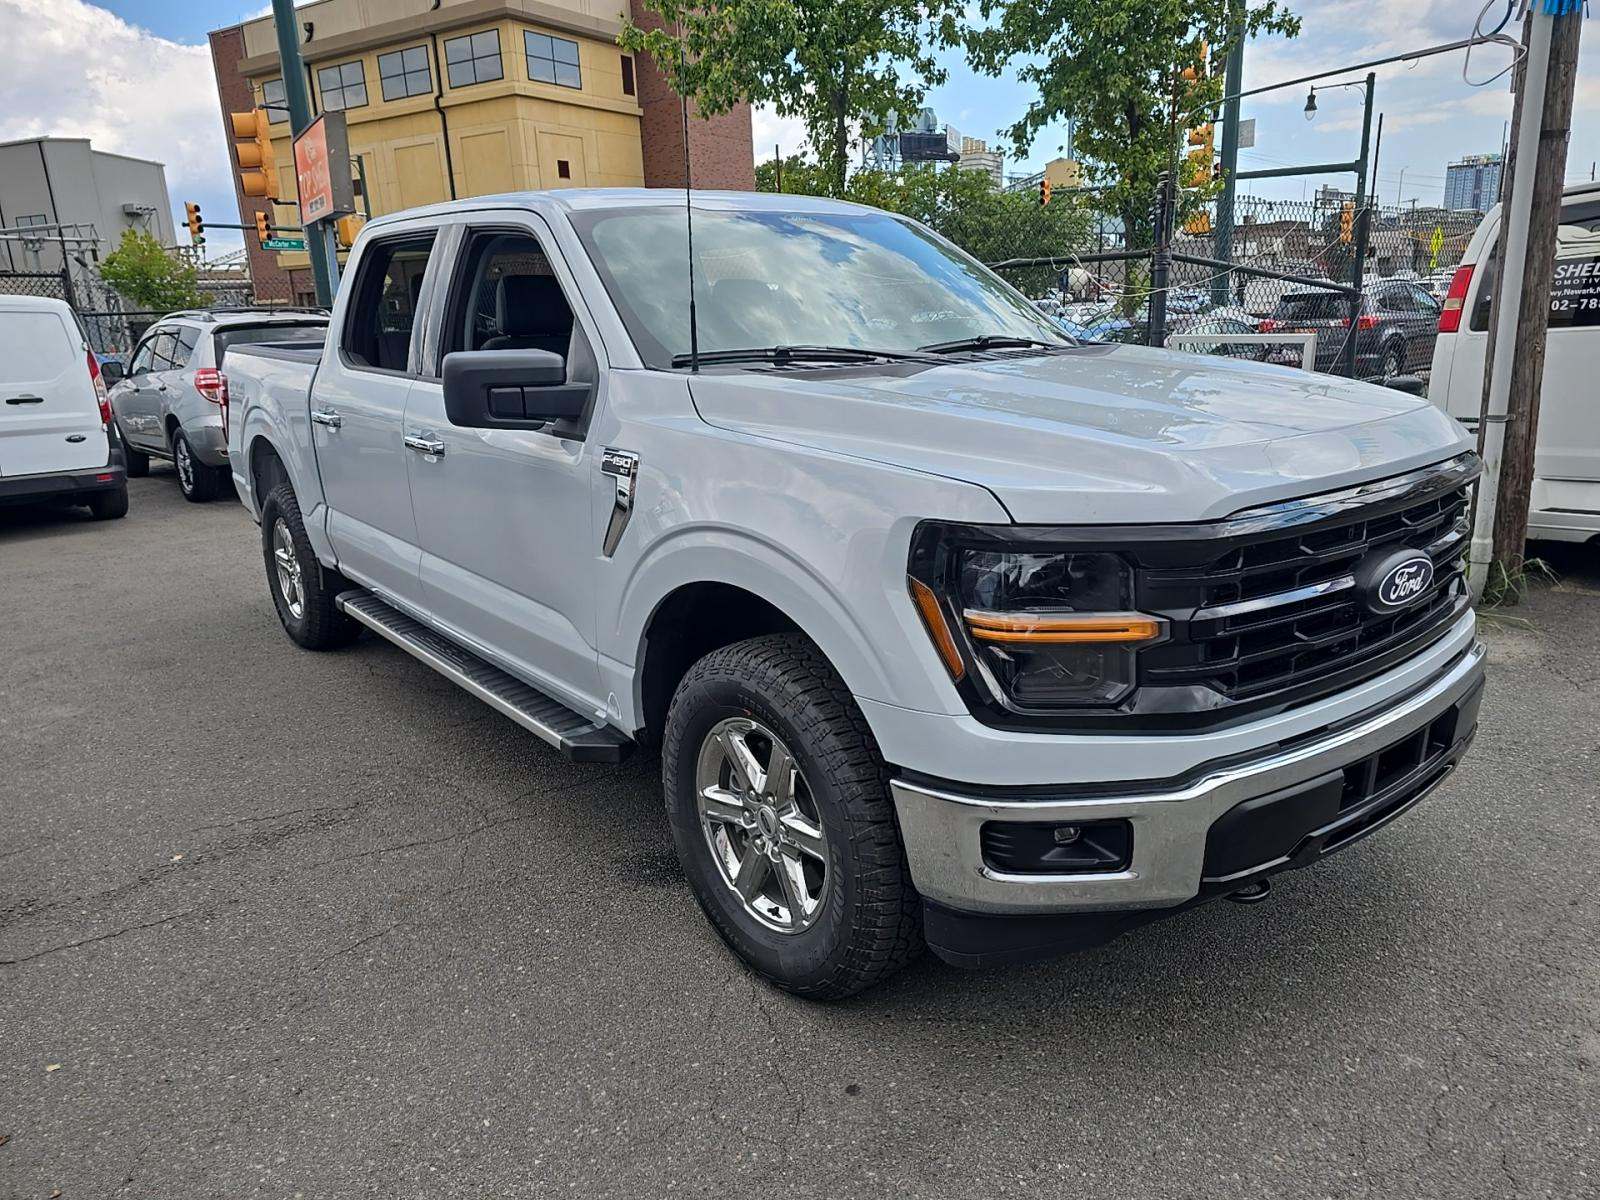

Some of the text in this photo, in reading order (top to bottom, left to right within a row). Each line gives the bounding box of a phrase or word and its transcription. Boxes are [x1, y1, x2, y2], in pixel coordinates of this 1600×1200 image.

[1552, 277, 1600, 286] OMOTIV
[1551, 298, 1600, 311] 02-78
[1390, 565, 1425, 600] Ford
